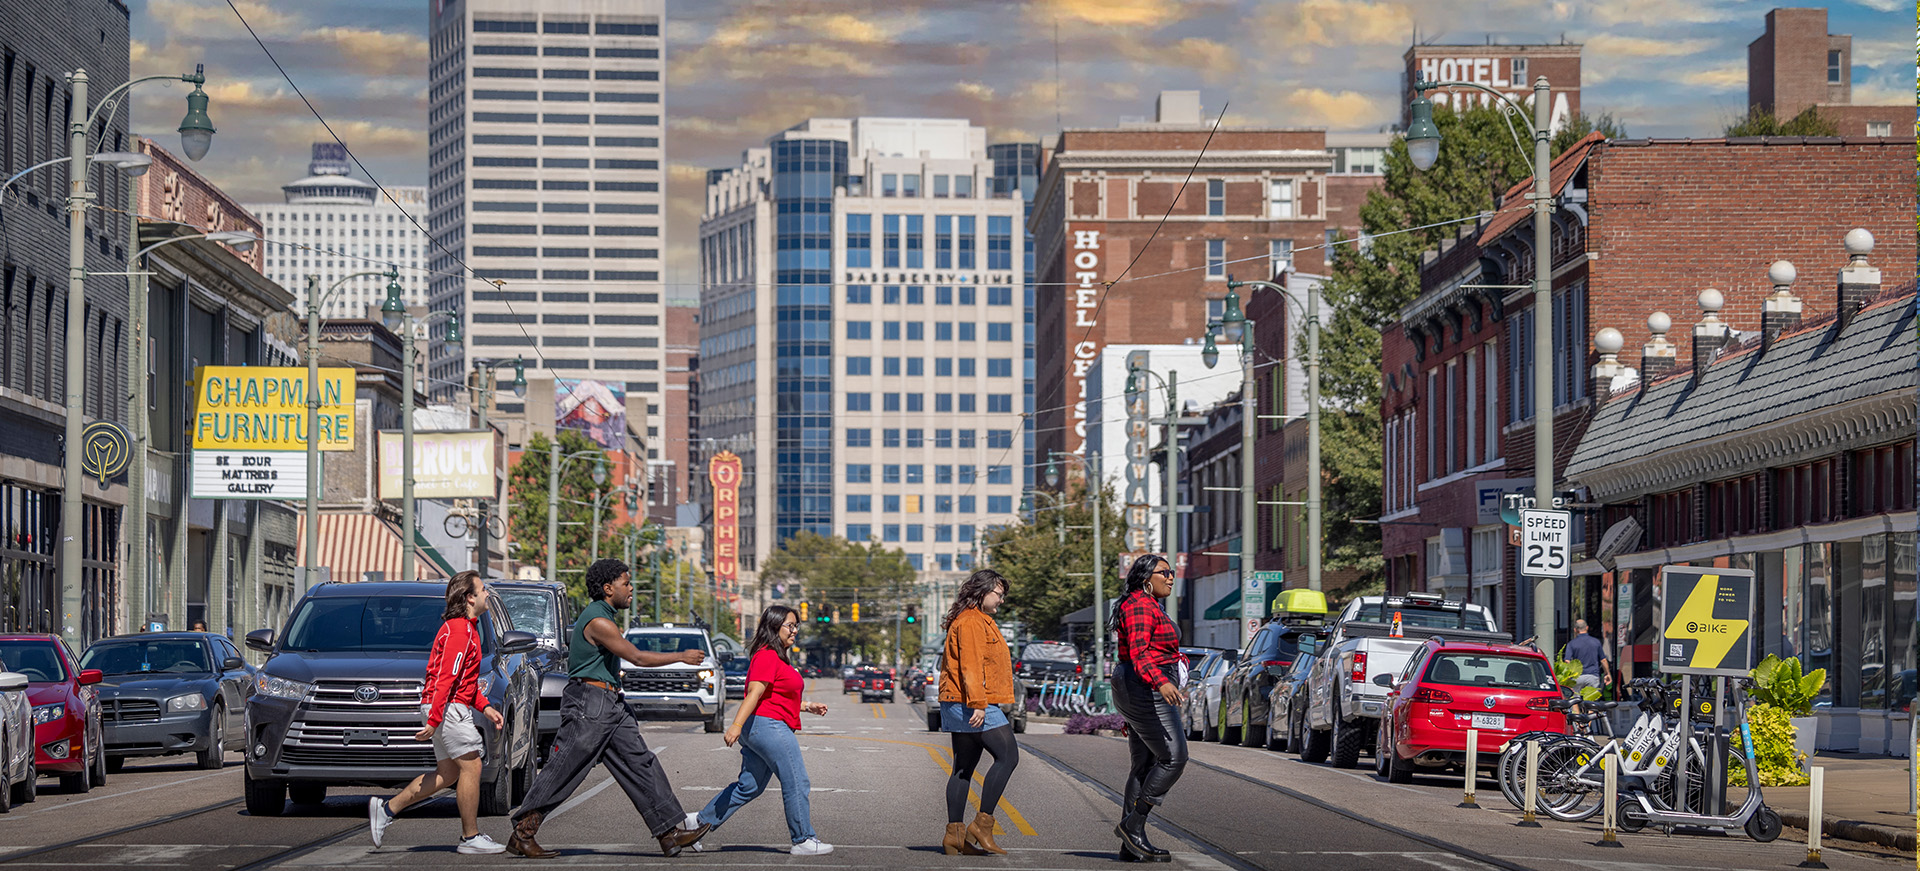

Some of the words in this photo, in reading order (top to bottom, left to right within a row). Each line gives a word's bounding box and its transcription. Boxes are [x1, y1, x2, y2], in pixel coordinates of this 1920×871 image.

[1421, 58, 1509, 87] HOTEL
[846, 273, 889, 283] BASS
[900, 273, 955, 284] BERRY
[973, 275, 1013, 284] SIMS
[1073, 231, 1099, 327] HOTEL
[198, 412, 349, 444] FURNITURE
[228, 483, 274, 493] GALLERY
[1527, 517, 1566, 529] SPEED
[1531, 531, 1562, 542] LIMIT
[1527, 544, 1565, 569] 25
